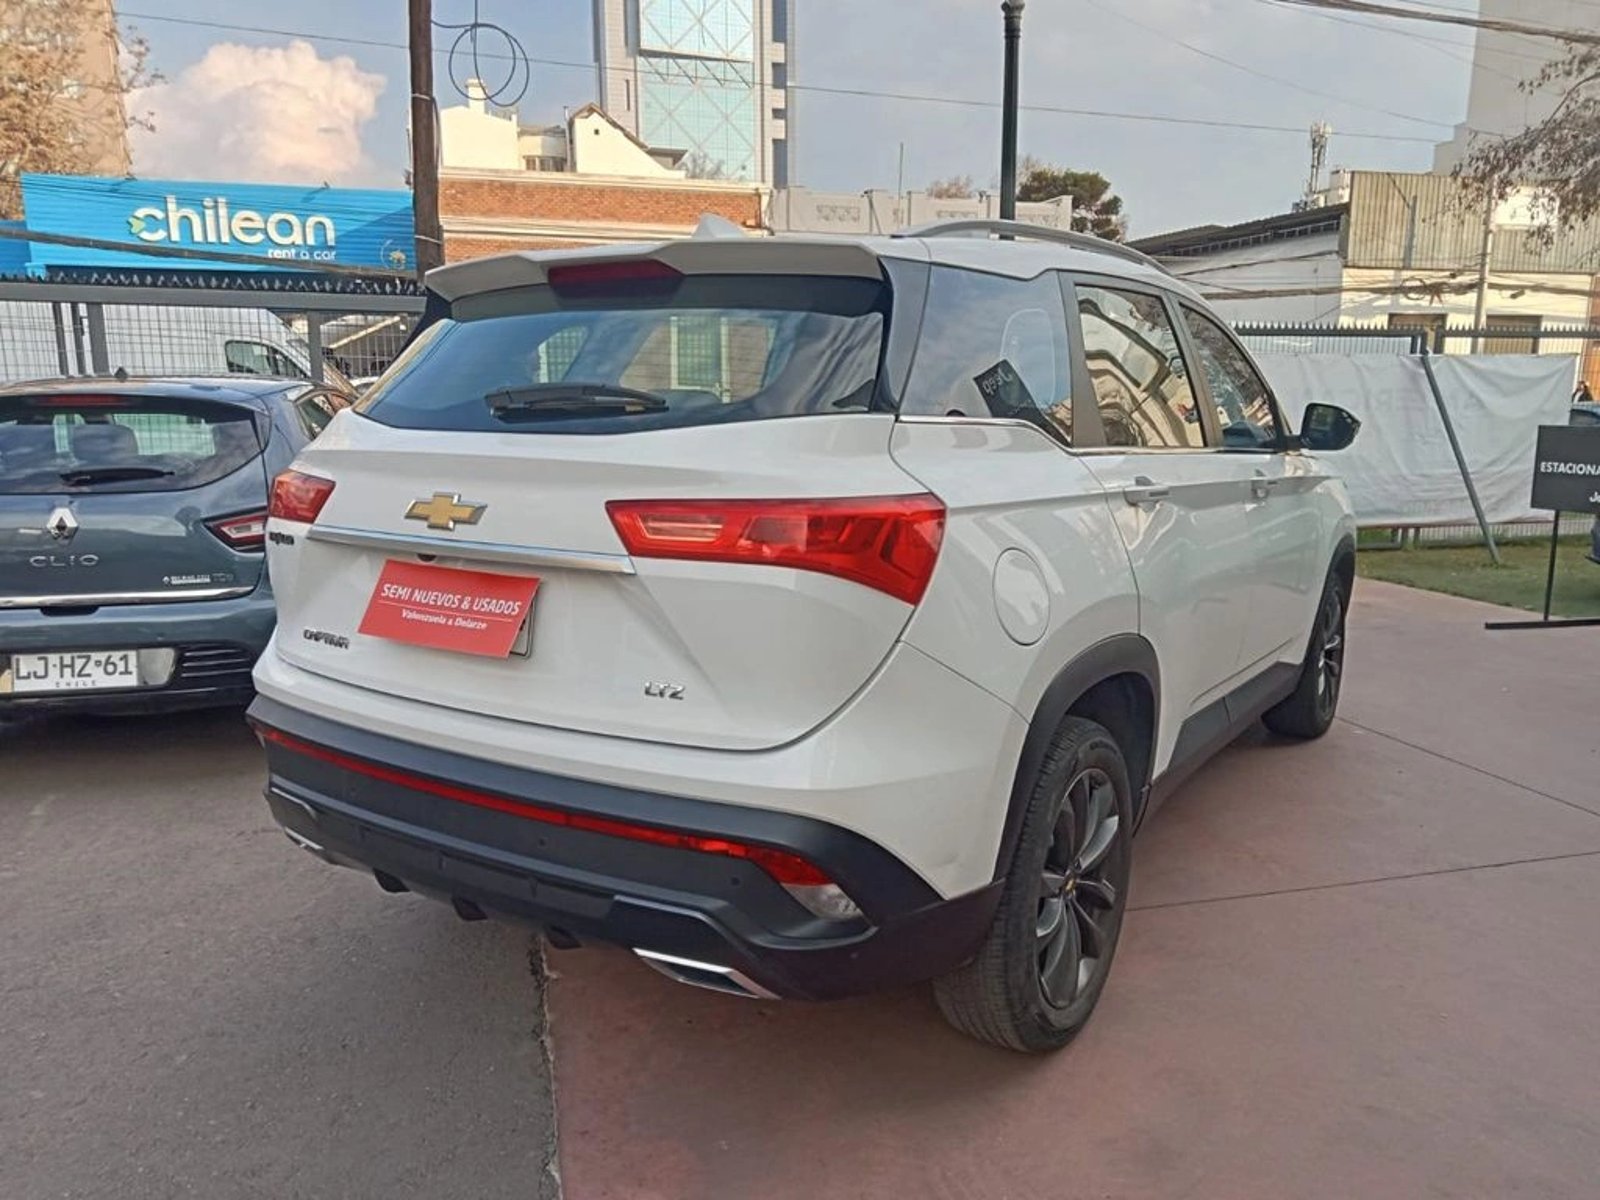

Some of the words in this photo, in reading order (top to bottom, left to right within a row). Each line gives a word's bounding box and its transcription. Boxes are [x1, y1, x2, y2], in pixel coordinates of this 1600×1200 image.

[130, 195, 336, 247] chilean
[268, 248, 297, 259] rent
[300, 251, 309, 259] a
[313, 251, 337, 260] car
[29, 554, 99, 567] CLIO
[381, 583, 411, 601] SEMI
[412, 588, 460, 609] NUEVOS
[461, 596, 473, 609] &
[473, 598, 523, 616] USADOS
[644, 681, 686, 700] LTZ
